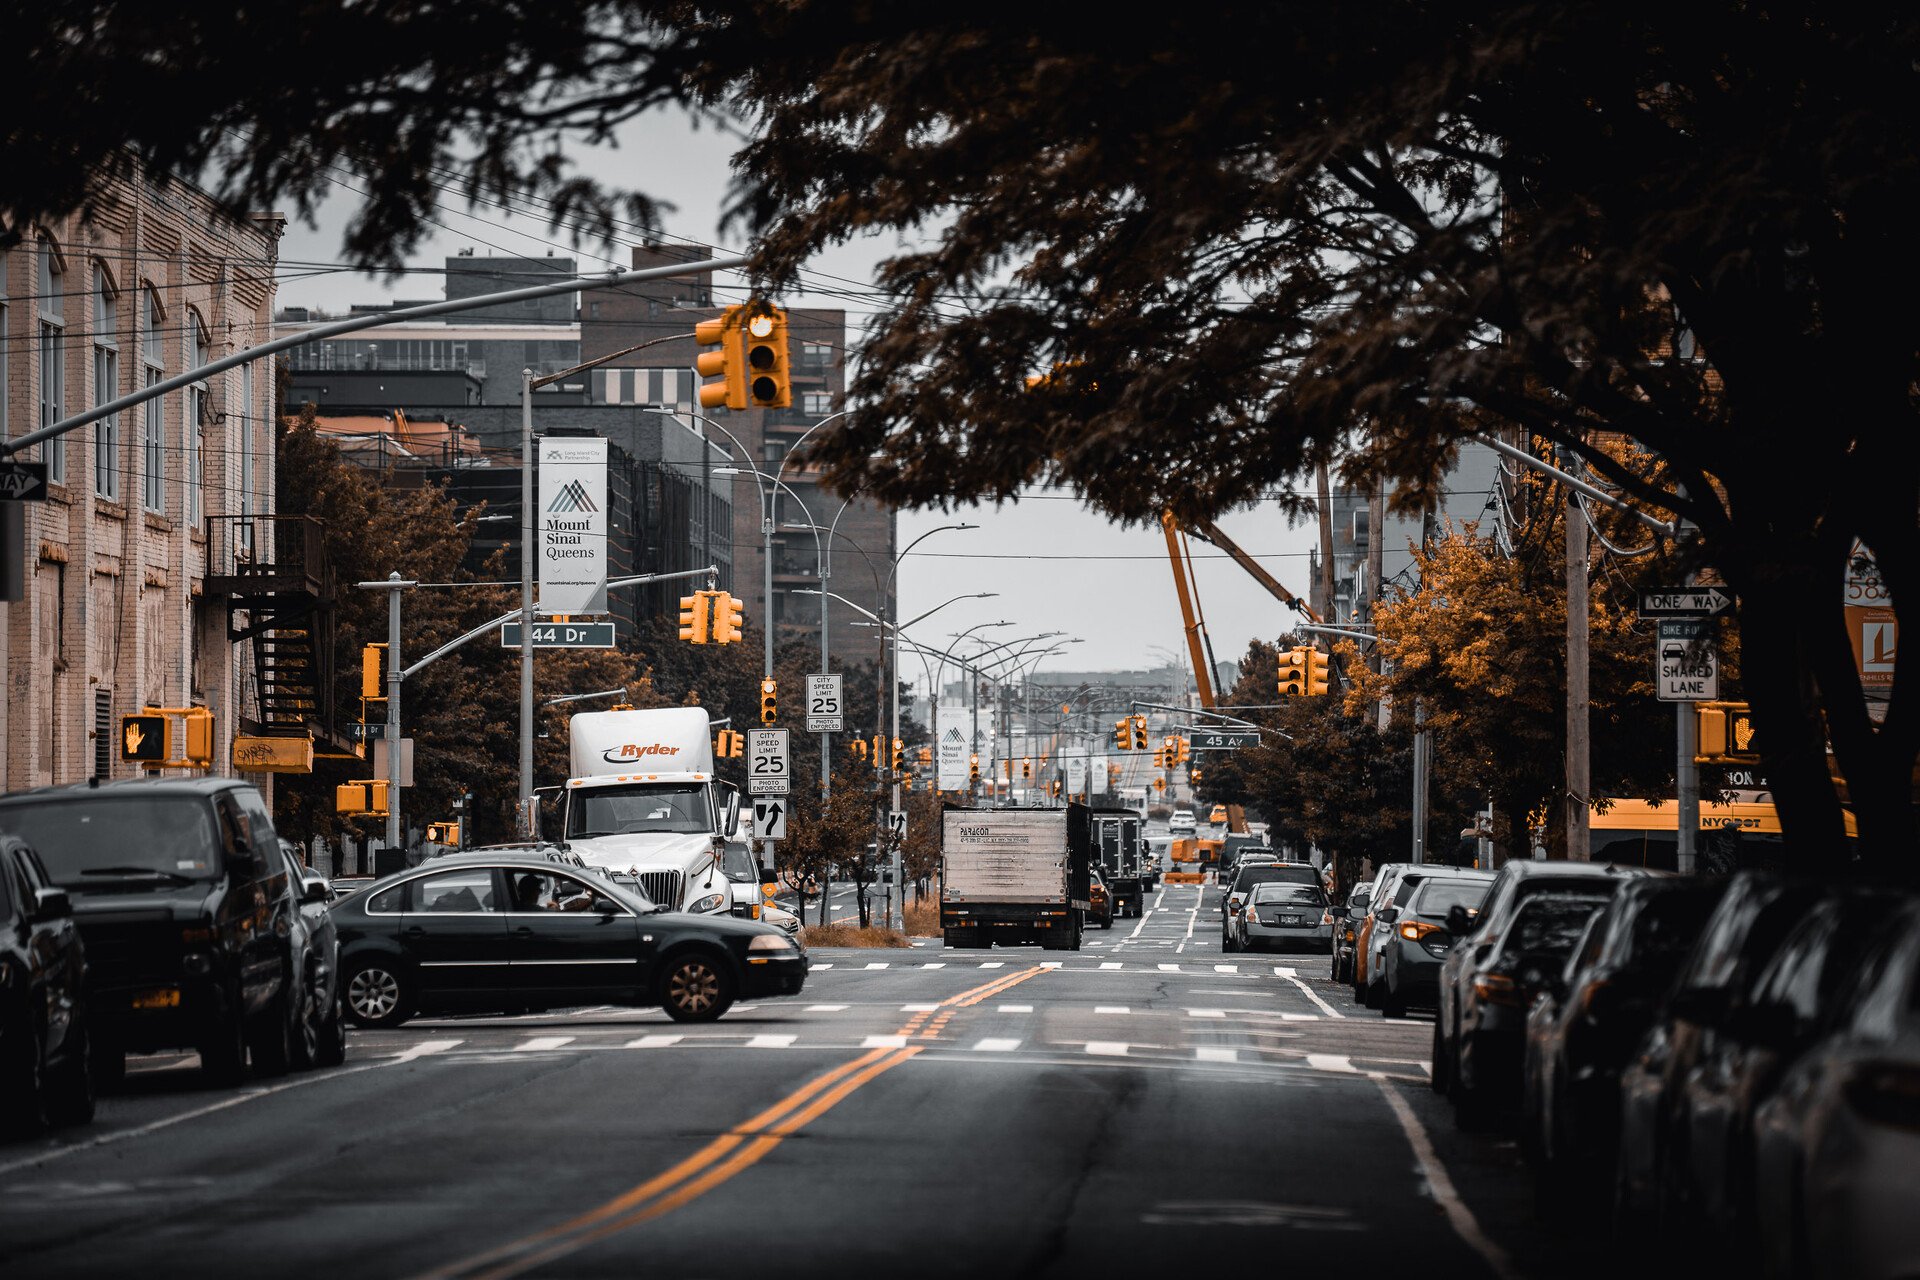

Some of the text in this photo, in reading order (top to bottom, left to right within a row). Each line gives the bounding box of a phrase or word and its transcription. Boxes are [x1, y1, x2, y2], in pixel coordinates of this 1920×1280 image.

[546, 519, 591, 531] Mount
[546, 533, 581, 545] Sinai
[546, 547, 594, 561] Queens
[1653, 596, 1722, 609] ONE WAY
[532, 628, 587, 642] 44 Dr
[1663, 625, 1681, 635] BIKE
[1663, 665, 1714, 678] SHARED
[1671, 681, 1704, 693] LANE
[812, 698, 838, 713] 25
[370, 726, 378, 734] Dr
[1206, 736, 1223, 746] 45
[621, 743, 680, 758] Ryder
[754, 756, 784, 773] 25
[960, 827, 989, 836] PARAGON
